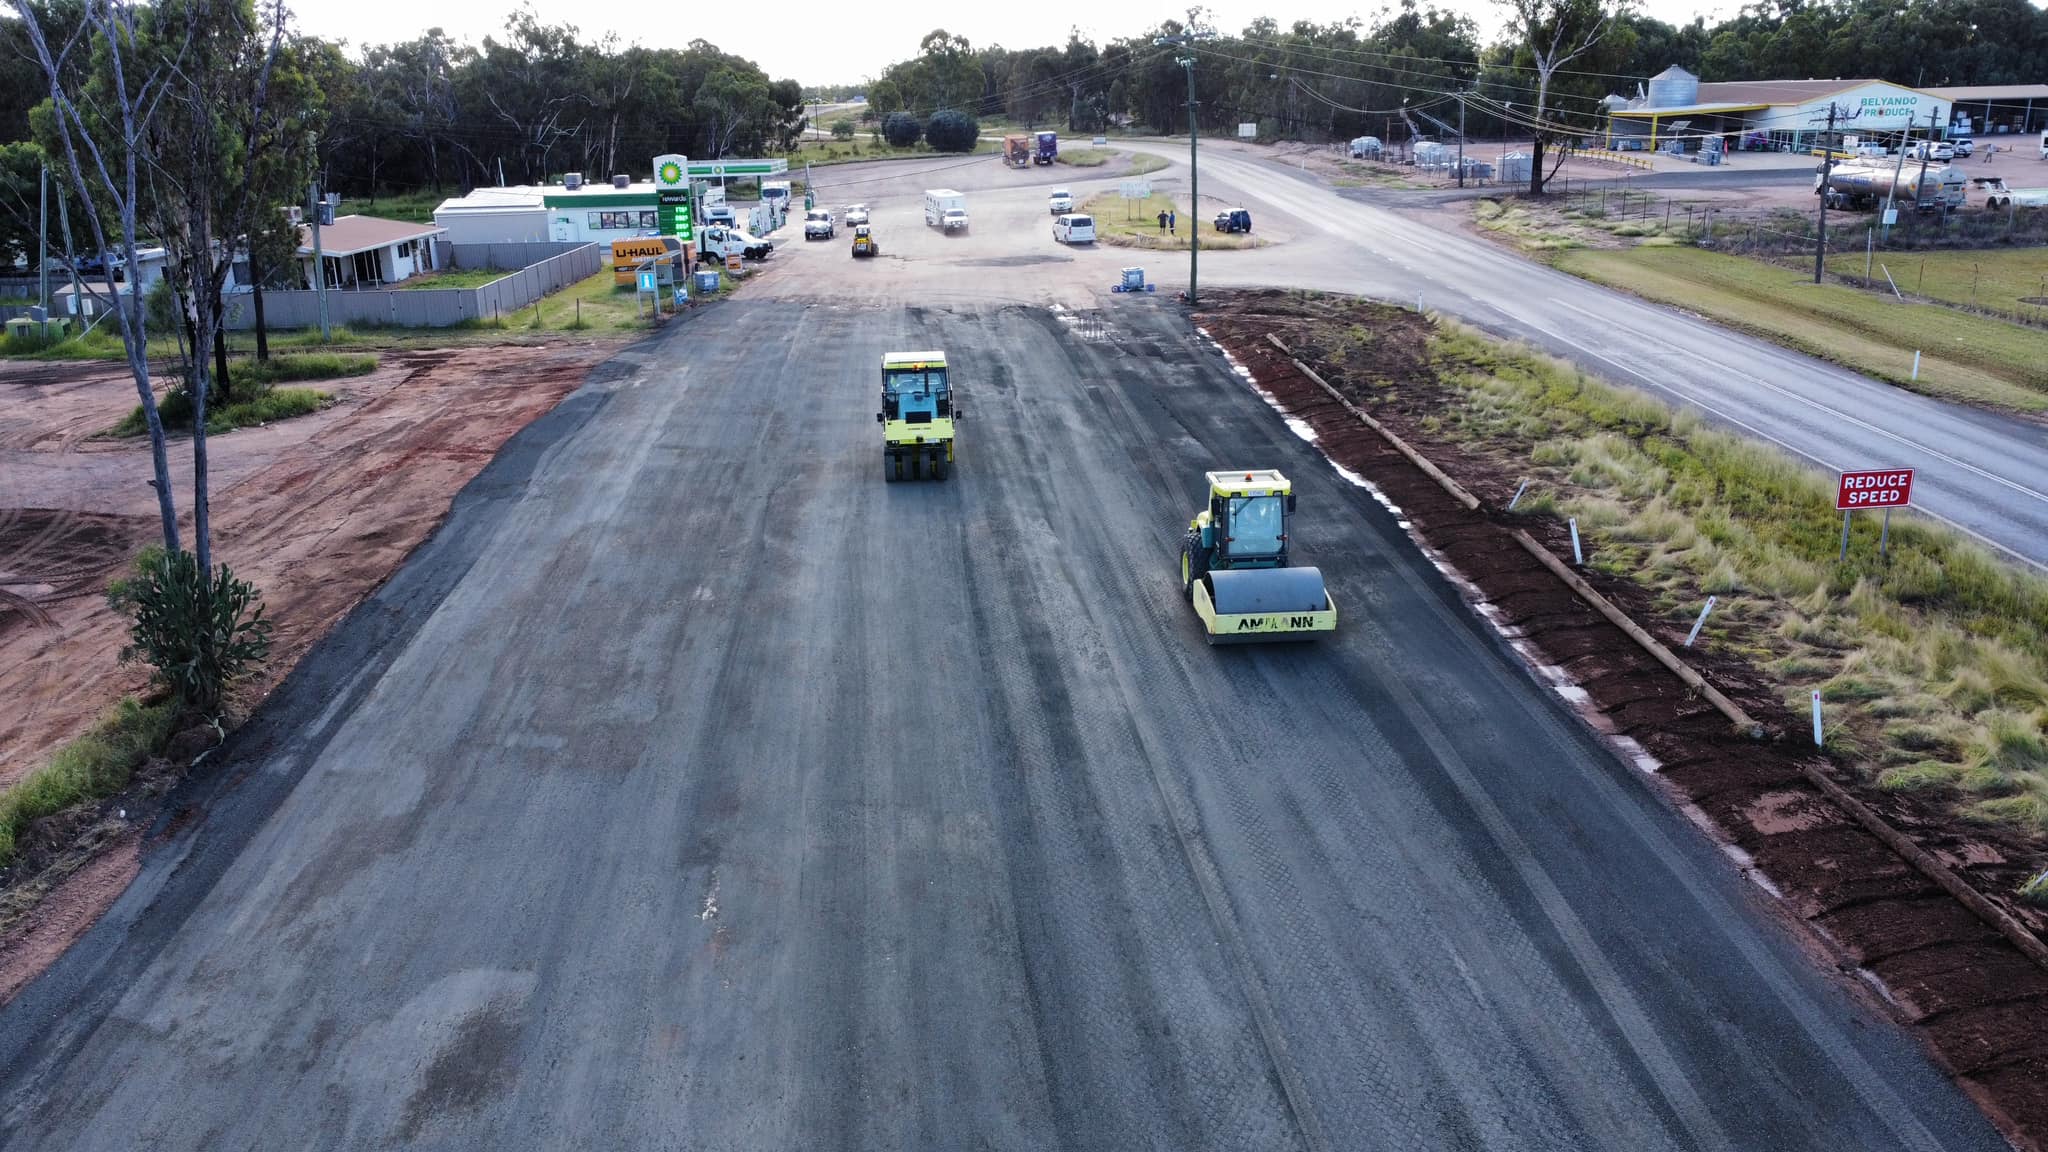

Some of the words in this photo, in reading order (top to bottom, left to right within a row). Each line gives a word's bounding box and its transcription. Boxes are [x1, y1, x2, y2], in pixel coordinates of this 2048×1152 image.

[1861, 97, 1917, 106] BELYANDO
[616, 247, 663, 258] U-HAUL
[1844, 474, 1908, 489] REDUCE
[1848, 490, 1900, 504] SPEED
